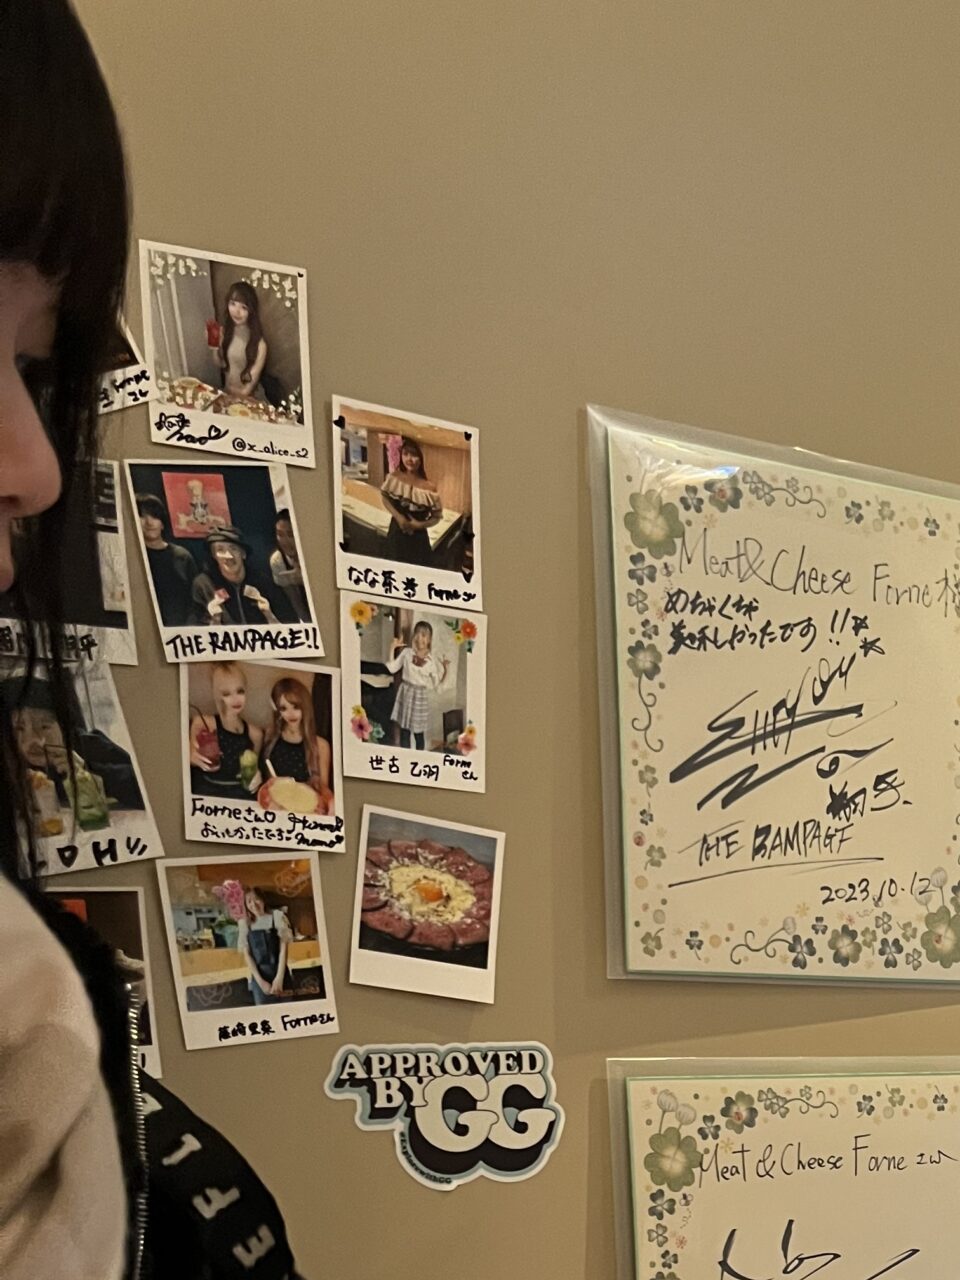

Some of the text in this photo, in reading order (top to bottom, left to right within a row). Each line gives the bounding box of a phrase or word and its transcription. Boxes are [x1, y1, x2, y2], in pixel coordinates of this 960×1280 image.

[663, 587, 760, 622] めちゃくちゃ
[165, 634, 208, 659] THE
[338, 1050, 545, 1080] APPROVED
[372, 1072, 557, 1153] BY GG
